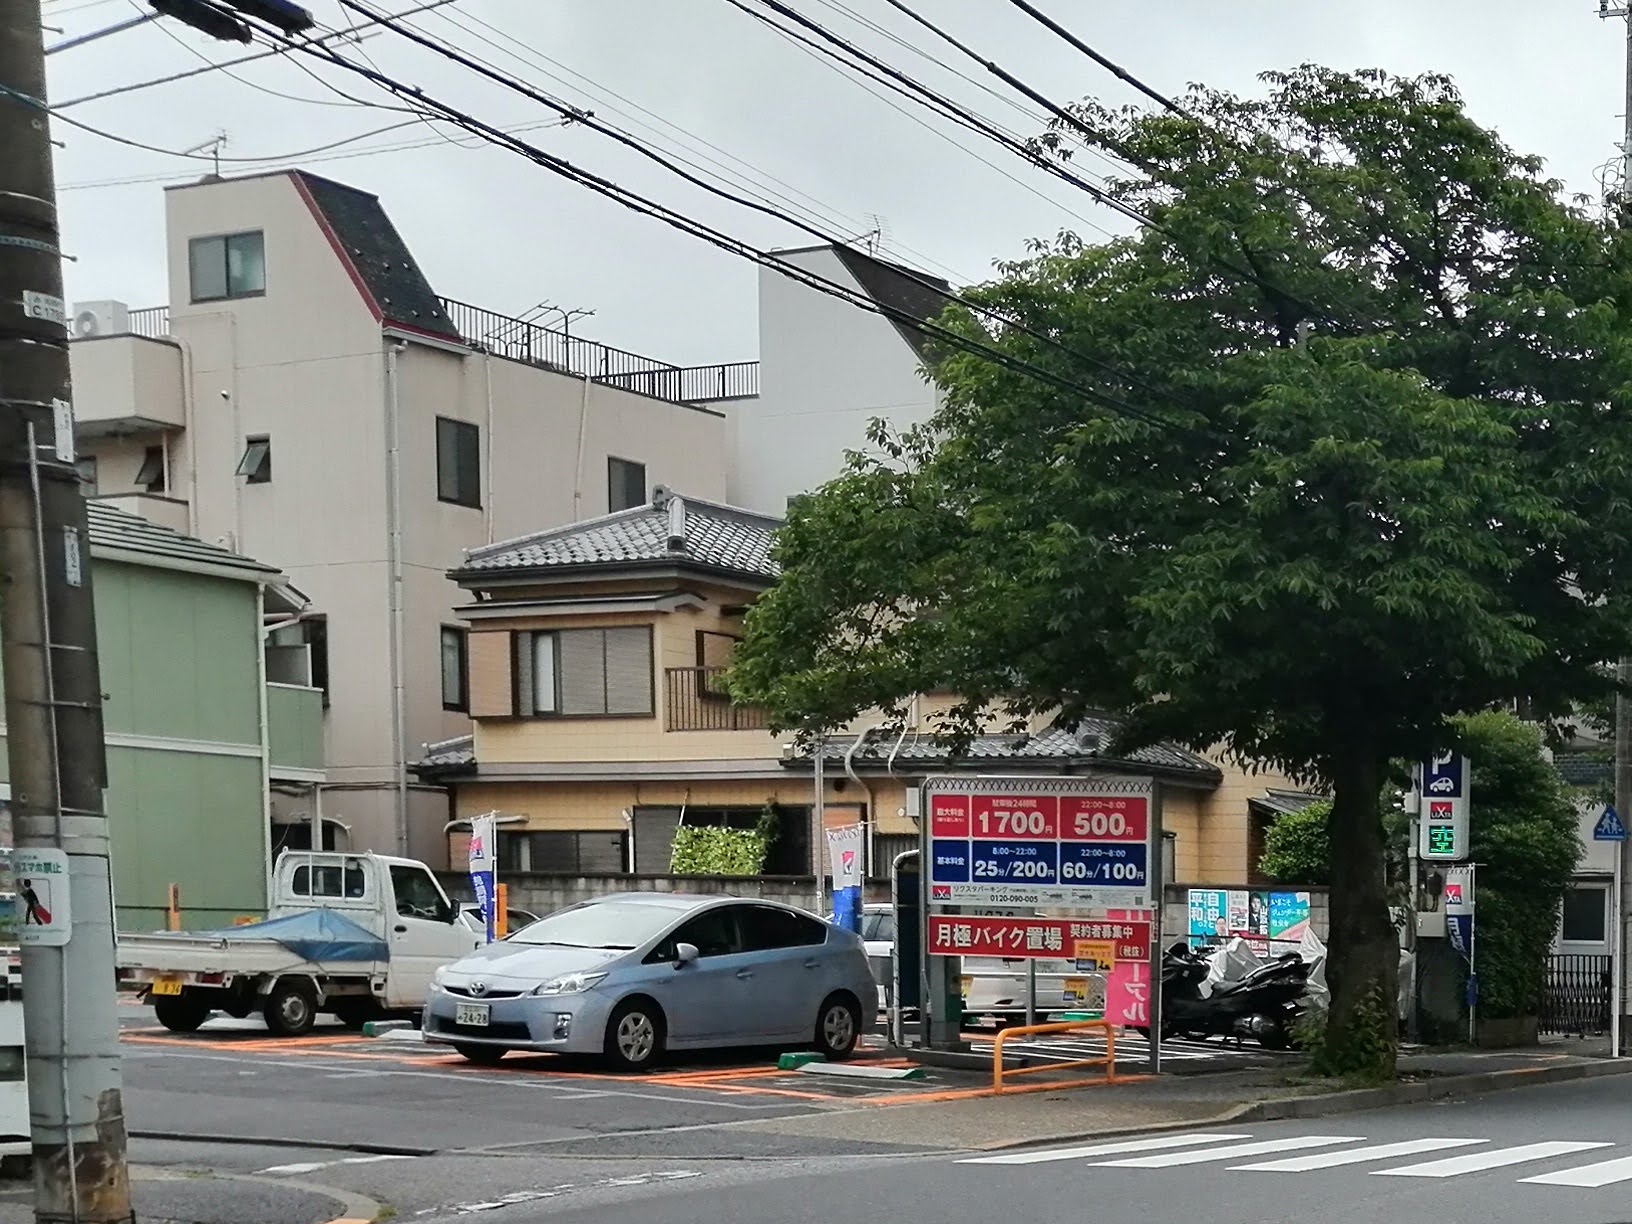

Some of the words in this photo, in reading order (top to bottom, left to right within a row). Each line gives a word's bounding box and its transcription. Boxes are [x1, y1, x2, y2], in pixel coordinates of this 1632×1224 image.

[936, 923, 1063, 951] 月極バイク置場
[1070, 923, 1133, 939] 契約者募集中
